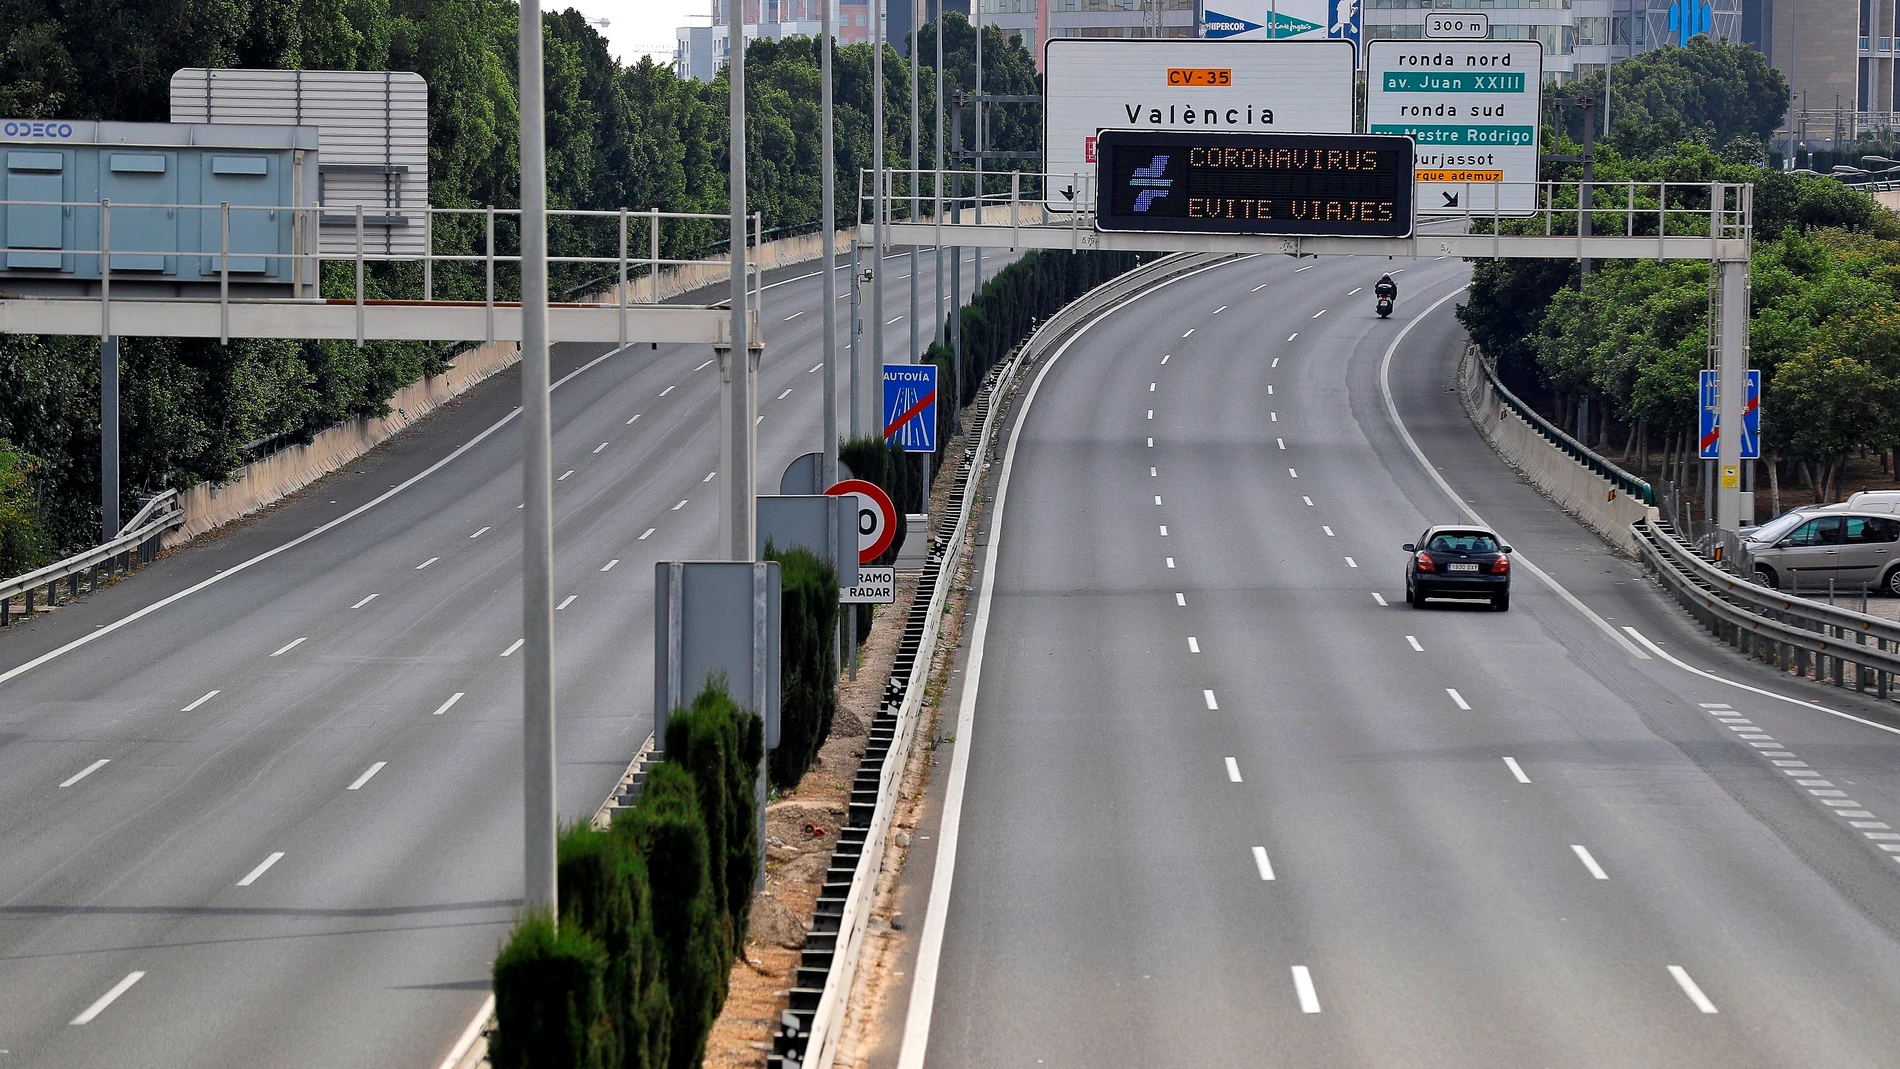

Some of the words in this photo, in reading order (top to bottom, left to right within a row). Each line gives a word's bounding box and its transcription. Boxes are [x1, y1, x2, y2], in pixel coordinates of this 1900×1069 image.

[1433, 20, 1463, 31] 300
[1470, 23, 1481, 31] m
[1399, 53, 1454, 66] ronda
[1466, 53, 1511, 66] nord
[1169, 71, 1230, 84] CV-35
[1388, 78, 1411, 88] av.
[1419, 75, 1462, 89] Juan
[1474, 76, 1519, 89] XXIII
[1125, 104, 1274, 124] València
[1401, 104, 1456, 117] ronda
[1470, 104, 1505, 117] sud
[4, 121, 73, 138] ODECO
[1467, 129, 1530, 146] Rodrigo
[1190, 147, 1377, 170] CORONAVIRUS
[1415, 172, 1445, 181] rque
[1451, 172, 1500, 181] ademuz
[1189, 198, 1272, 219] EVITE
[1292, 200, 1393, 222] VIAJES
[883, 370, 930, 382] AUTOVÍA
[858, 508, 877, 535] 0
[858, 573, 892, 583] RAMO
[849, 587, 891, 597] RADAR
